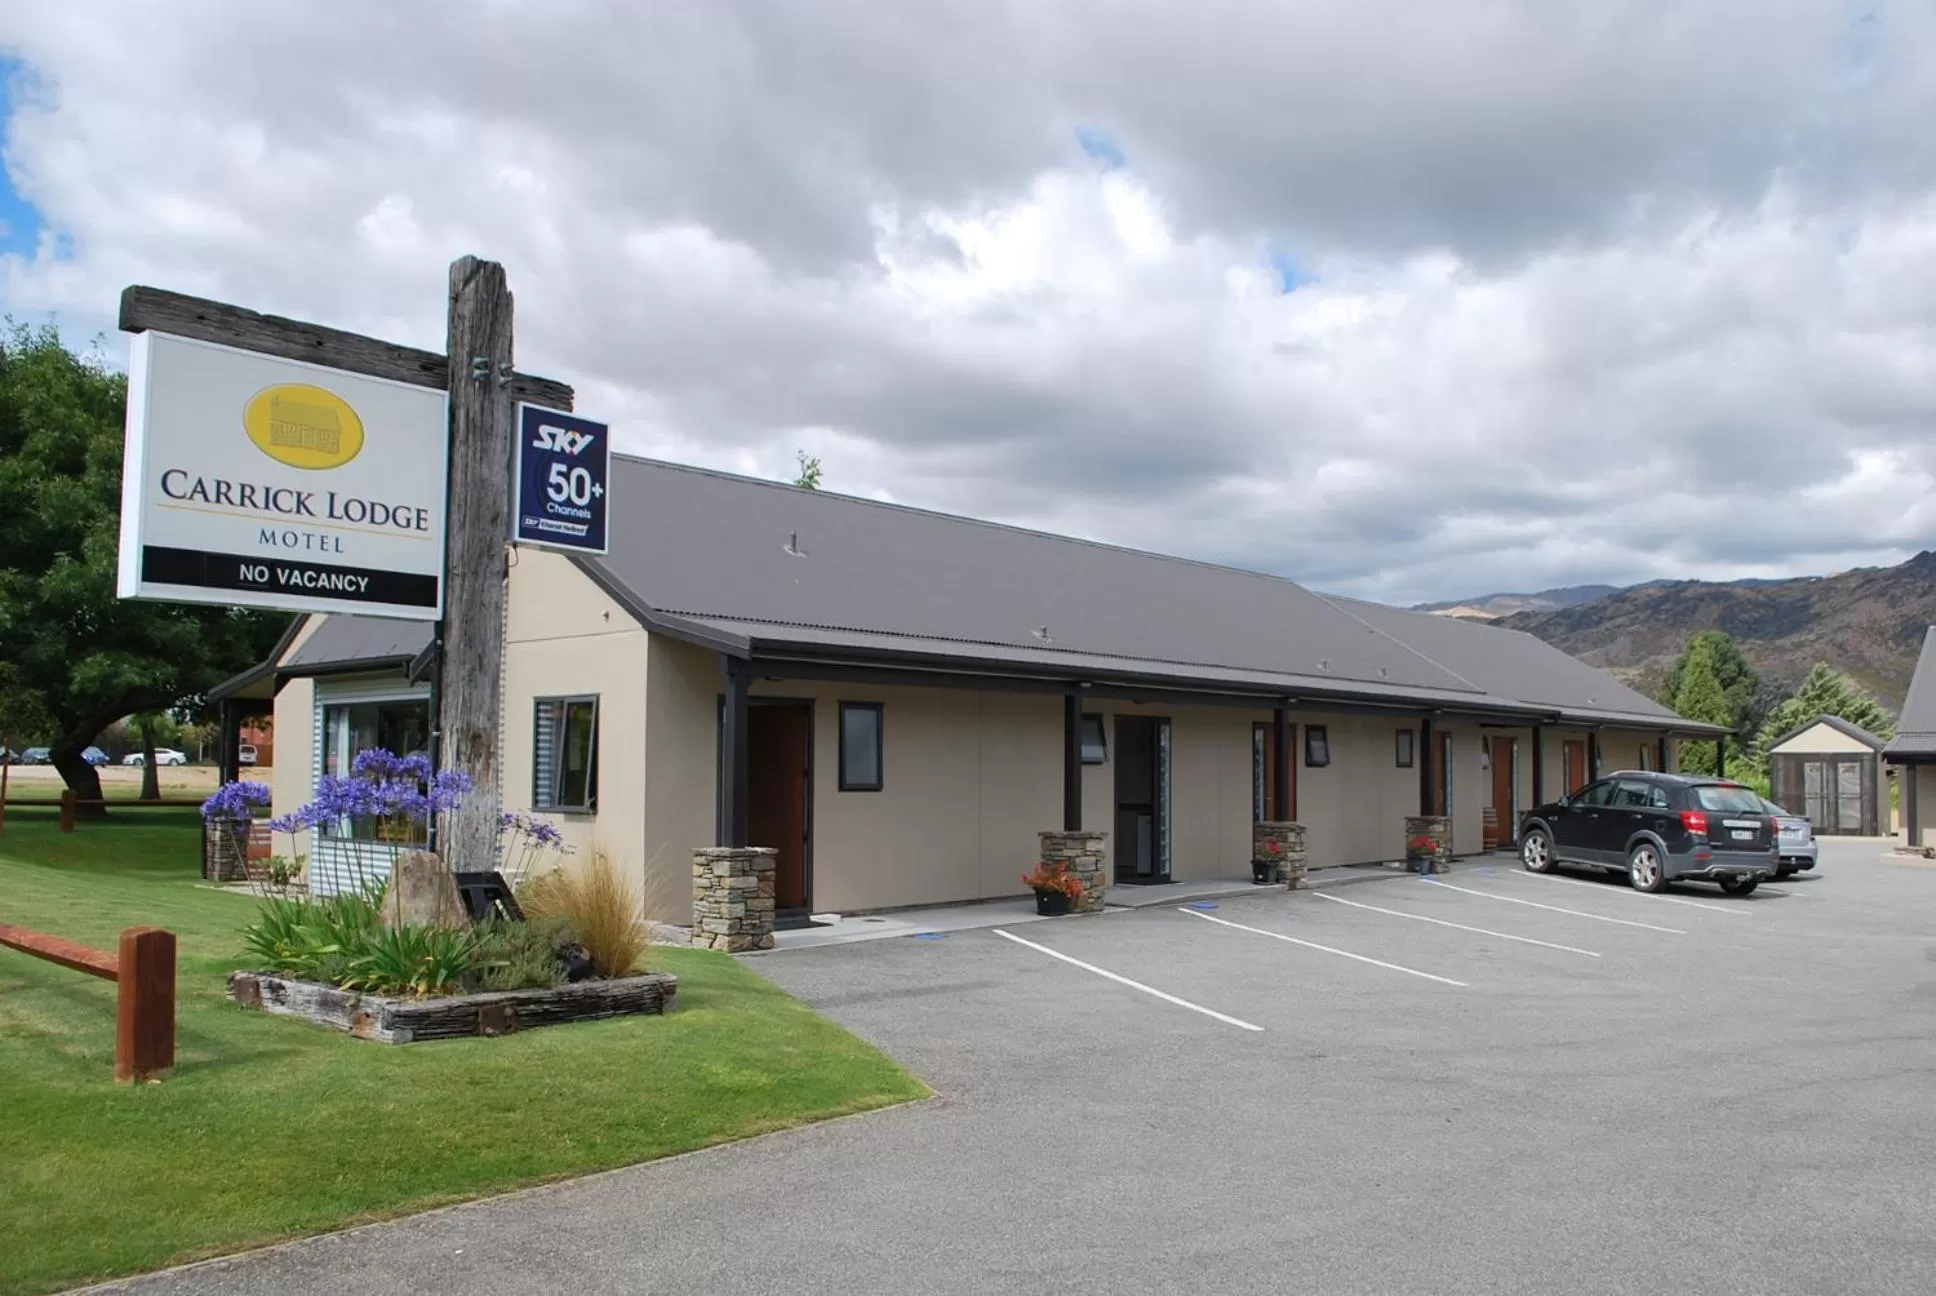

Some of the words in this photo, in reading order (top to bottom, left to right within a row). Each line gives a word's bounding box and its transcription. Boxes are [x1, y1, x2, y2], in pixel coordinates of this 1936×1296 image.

[532, 424, 594, 456] SKY
[161, 469, 317, 517] CARRICK
[327, 491, 429, 532] LODGE
[546, 502, 592, 519] Channels
[259, 528, 345, 553] MOTEL
[240, 564, 269, 583] NO
[277, 568, 369, 593] VACANCY
